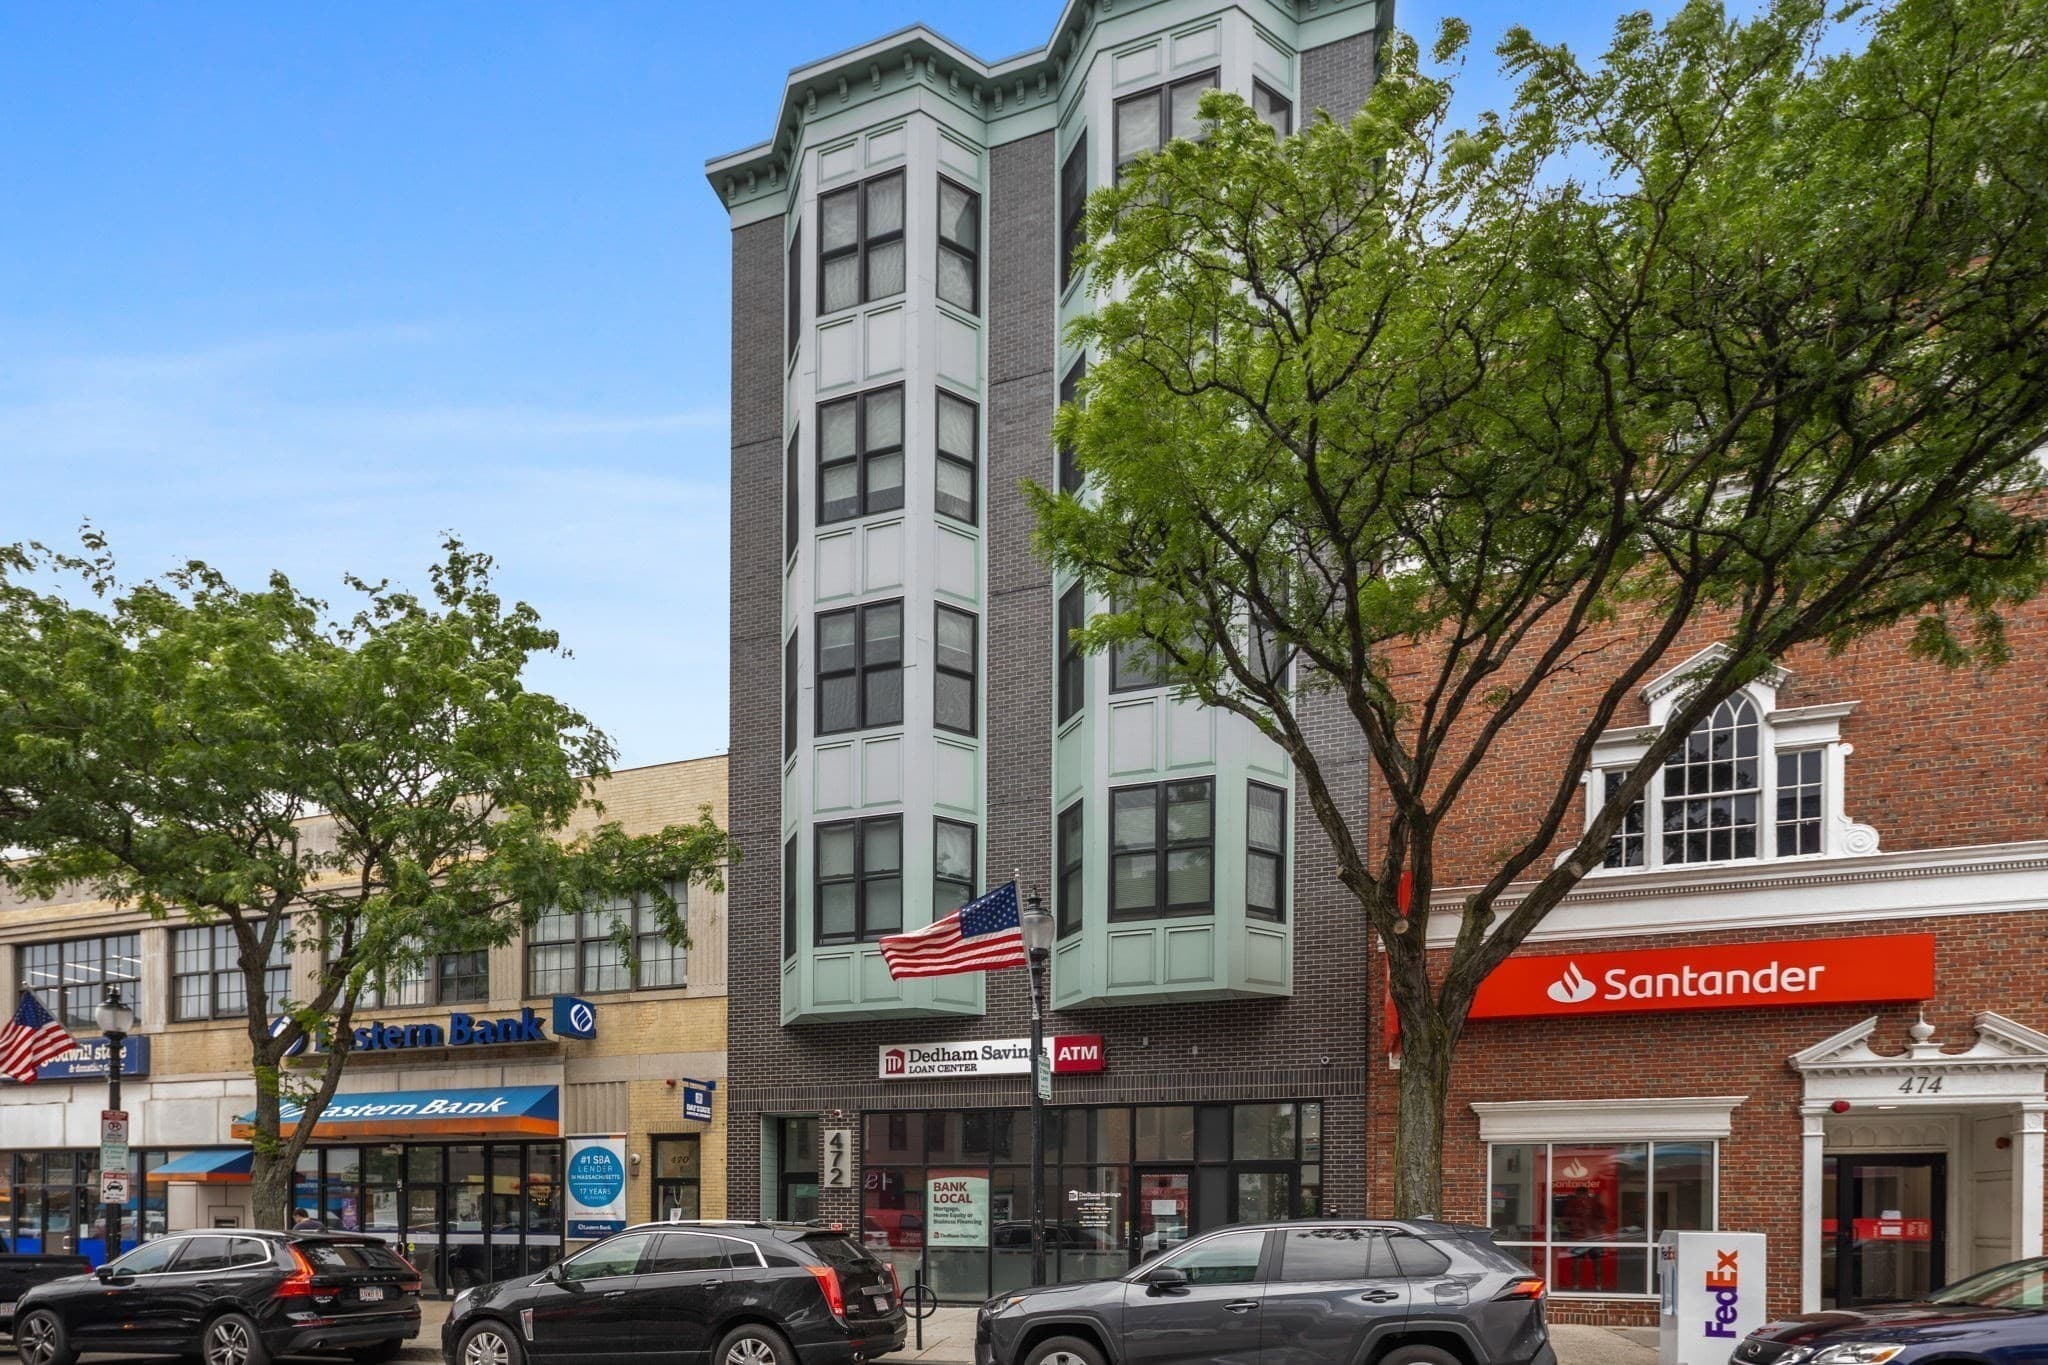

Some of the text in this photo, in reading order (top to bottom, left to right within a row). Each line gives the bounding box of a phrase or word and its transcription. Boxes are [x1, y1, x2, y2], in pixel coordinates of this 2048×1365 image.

[1603, 961, 1825, 1000] Santander
[315, 1006, 546, 1051] Estern Bank
[908, 1043, 1048, 1063] Dedham Savins
[1058, 1046, 1098, 1061] ATM
[908, 1063, 978, 1074] LOAN CENTER
[1898, 1076, 1943, 1094] 474
[416, 1097, 509, 1115] Bank
[580, 1155, 611, 1165] #1 SBA
[670, 1155, 689, 1164] 470
[829, 1132, 843, 1185] 472
[577, 1165, 613, 1173] LENDER
[933, 1182, 967, 1192] BANK
[933, 1193, 973, 1204] LOCAL
[1705, 1248, 1738, 1338] FedEx
